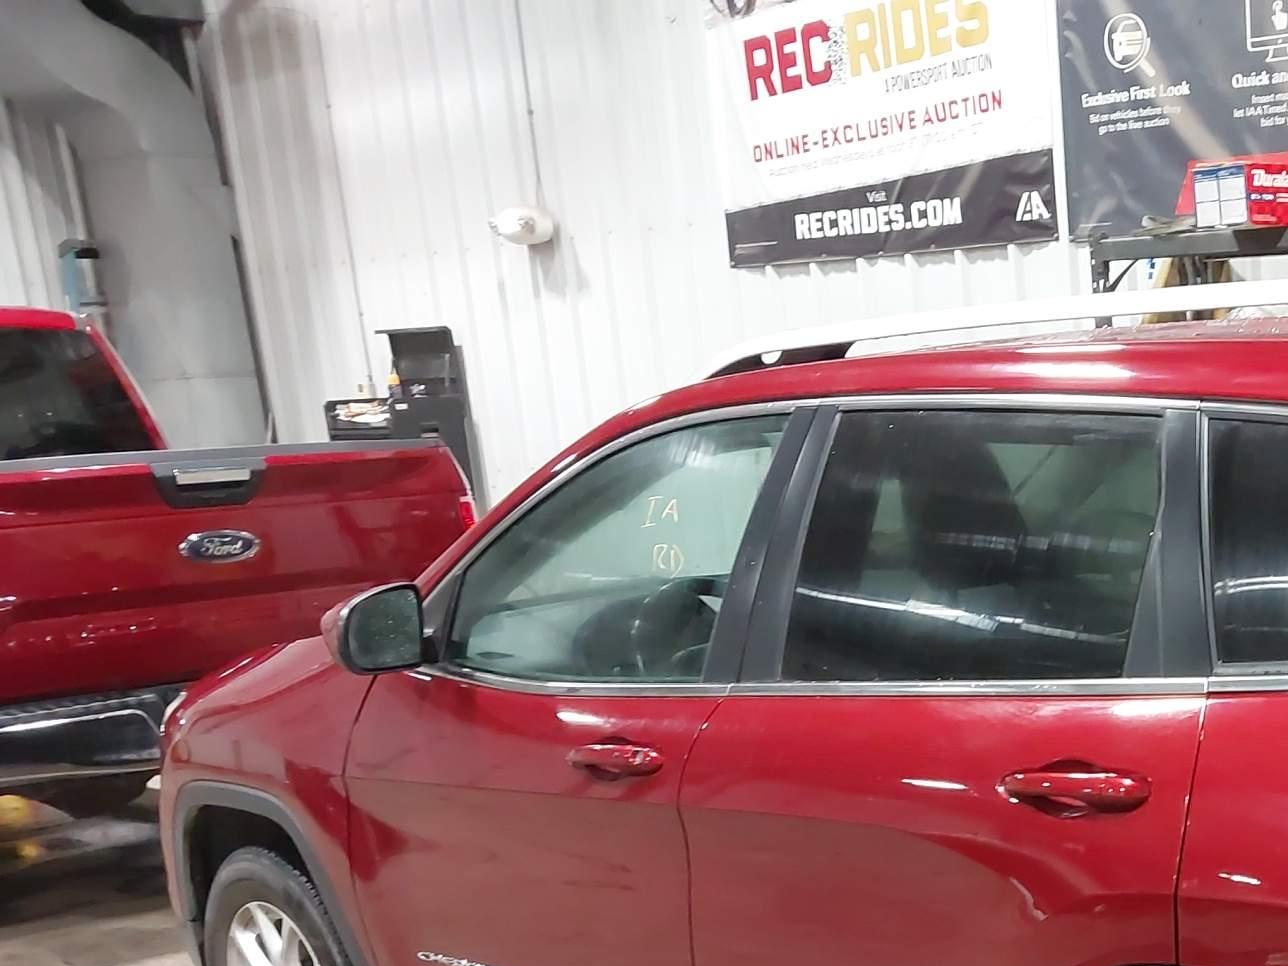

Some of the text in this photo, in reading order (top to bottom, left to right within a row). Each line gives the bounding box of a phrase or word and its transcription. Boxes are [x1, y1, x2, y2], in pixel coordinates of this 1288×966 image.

[951, 53, 992, 78] AUCTION
[1231, 70, 1270, 88] Quick
[1081, 80, 1191, 108] Exclusive First Look
[1245, 105, 1263, 117] IAA
[753, 110, 917, 163] ONLINE-EXCLUSIVE
[922, 90, 1003, 126] AUCTION
[794, 197, 963, 240] RECRIDES.COM
[200, 536, 244, 556] Ford
